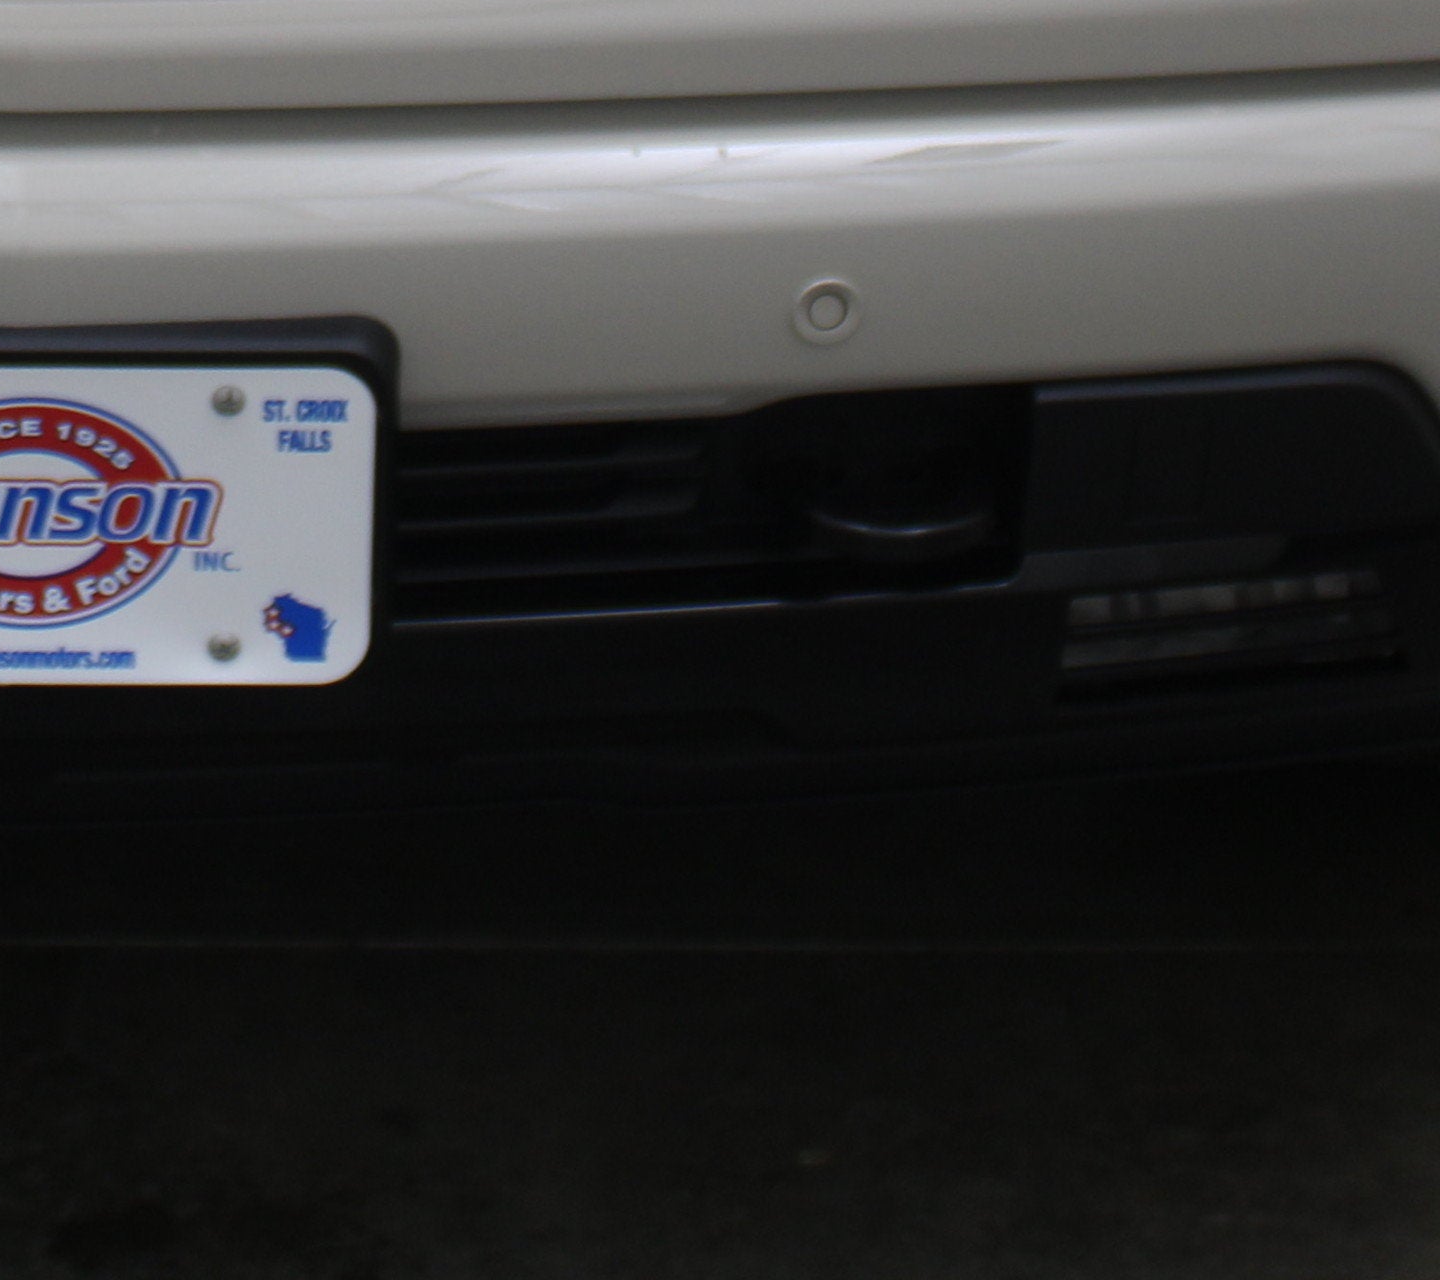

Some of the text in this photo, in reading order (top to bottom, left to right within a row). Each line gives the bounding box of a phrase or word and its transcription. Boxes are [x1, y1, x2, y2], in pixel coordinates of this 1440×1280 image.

[263, 400, 348, 422] ST. CROIX
[278, 430, 332, 452] FALLS
[193, 552, 241, 573] INC.
[42, 586, 71, 614] &
[75, 546, 152, 606] Ford
